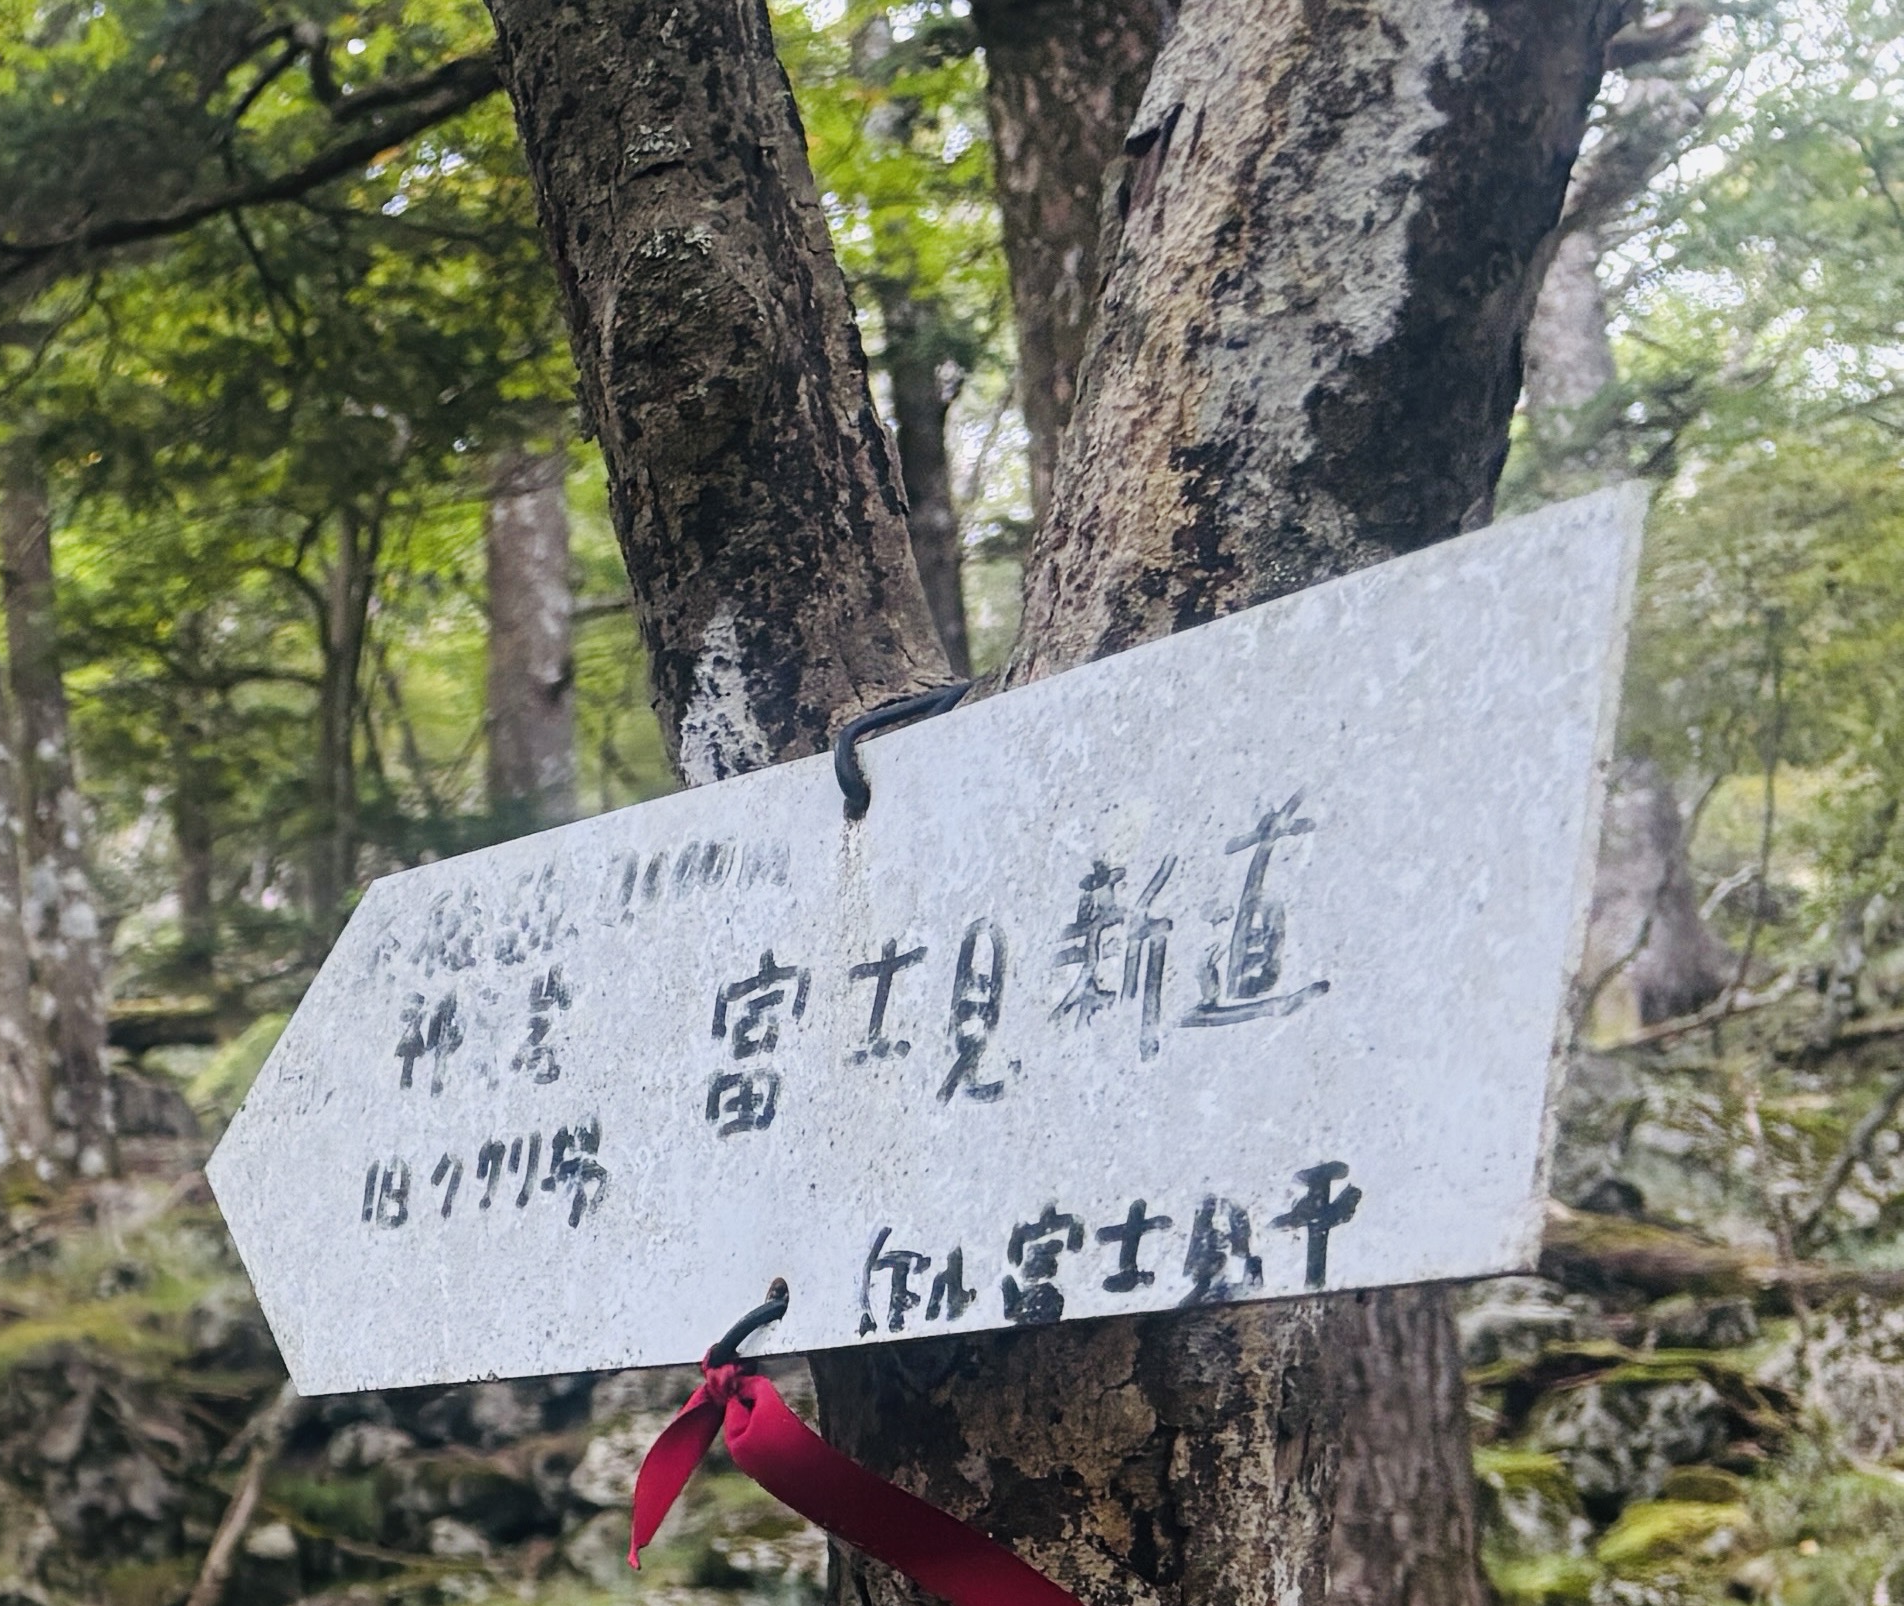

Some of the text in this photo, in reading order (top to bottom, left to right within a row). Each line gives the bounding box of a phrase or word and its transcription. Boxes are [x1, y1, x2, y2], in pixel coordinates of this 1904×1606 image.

[706, 788, 1330, 1138] 富士見新道
